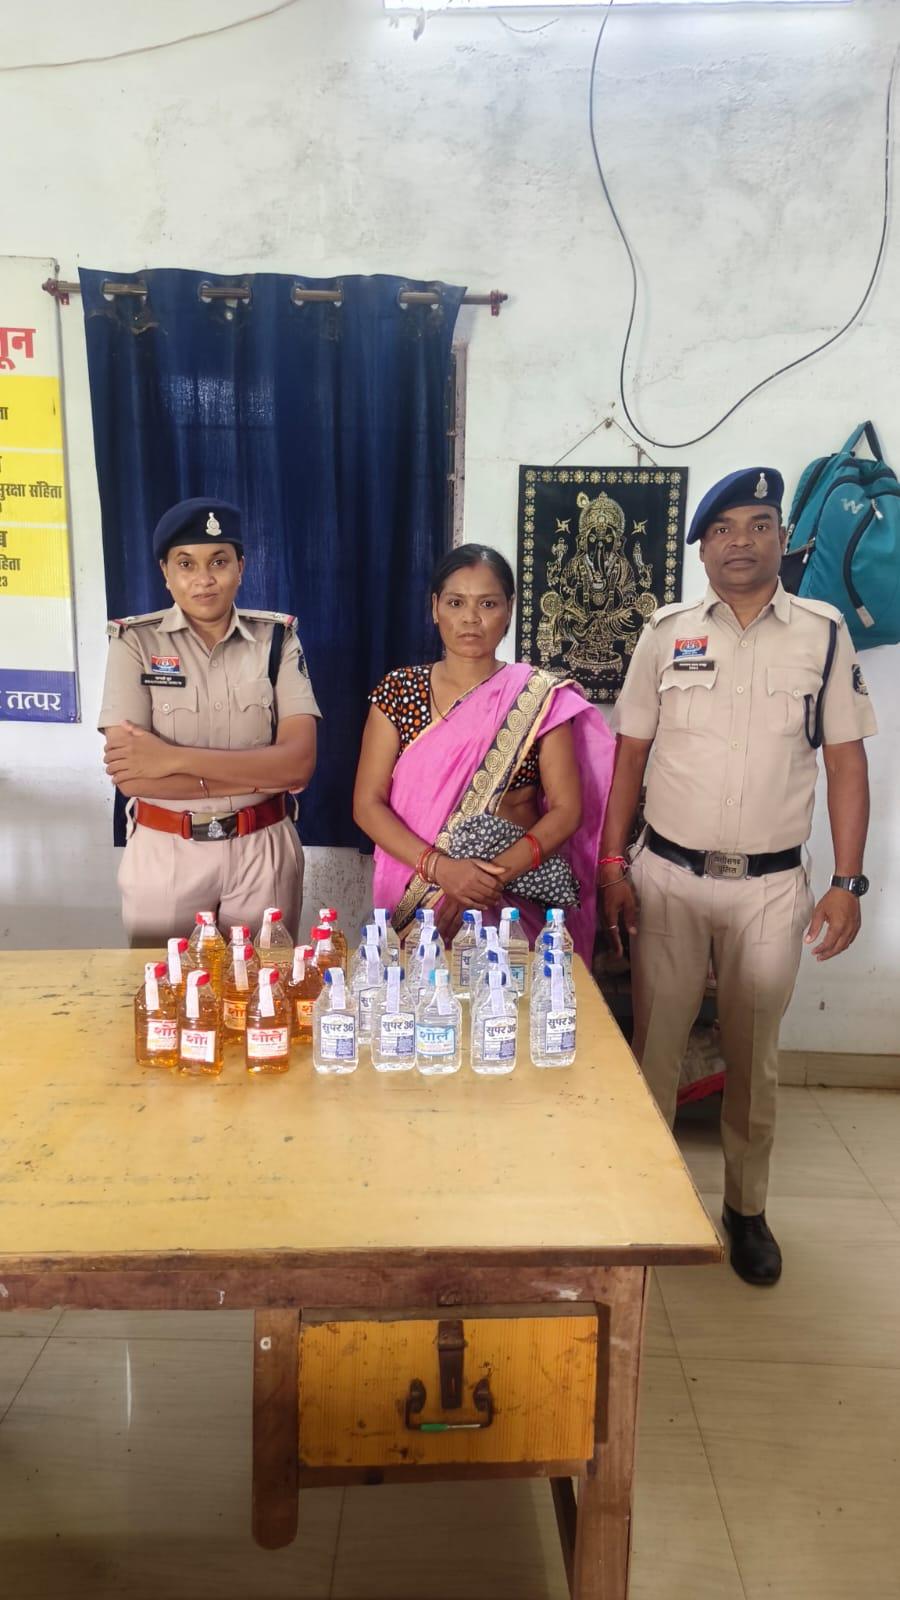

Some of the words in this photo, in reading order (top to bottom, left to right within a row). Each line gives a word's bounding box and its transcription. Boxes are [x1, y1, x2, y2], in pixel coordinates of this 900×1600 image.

[29, 481, 63, 499] संहिता
[5, 690, 62, 711] तत्पर
[322, 1023, 342, 1034] सुपर
[382, 1021, 402, 1032] सुपर
[548, 1017, 567, 1029] सुपर
[486, 1026, 507, 1037] सुपर
